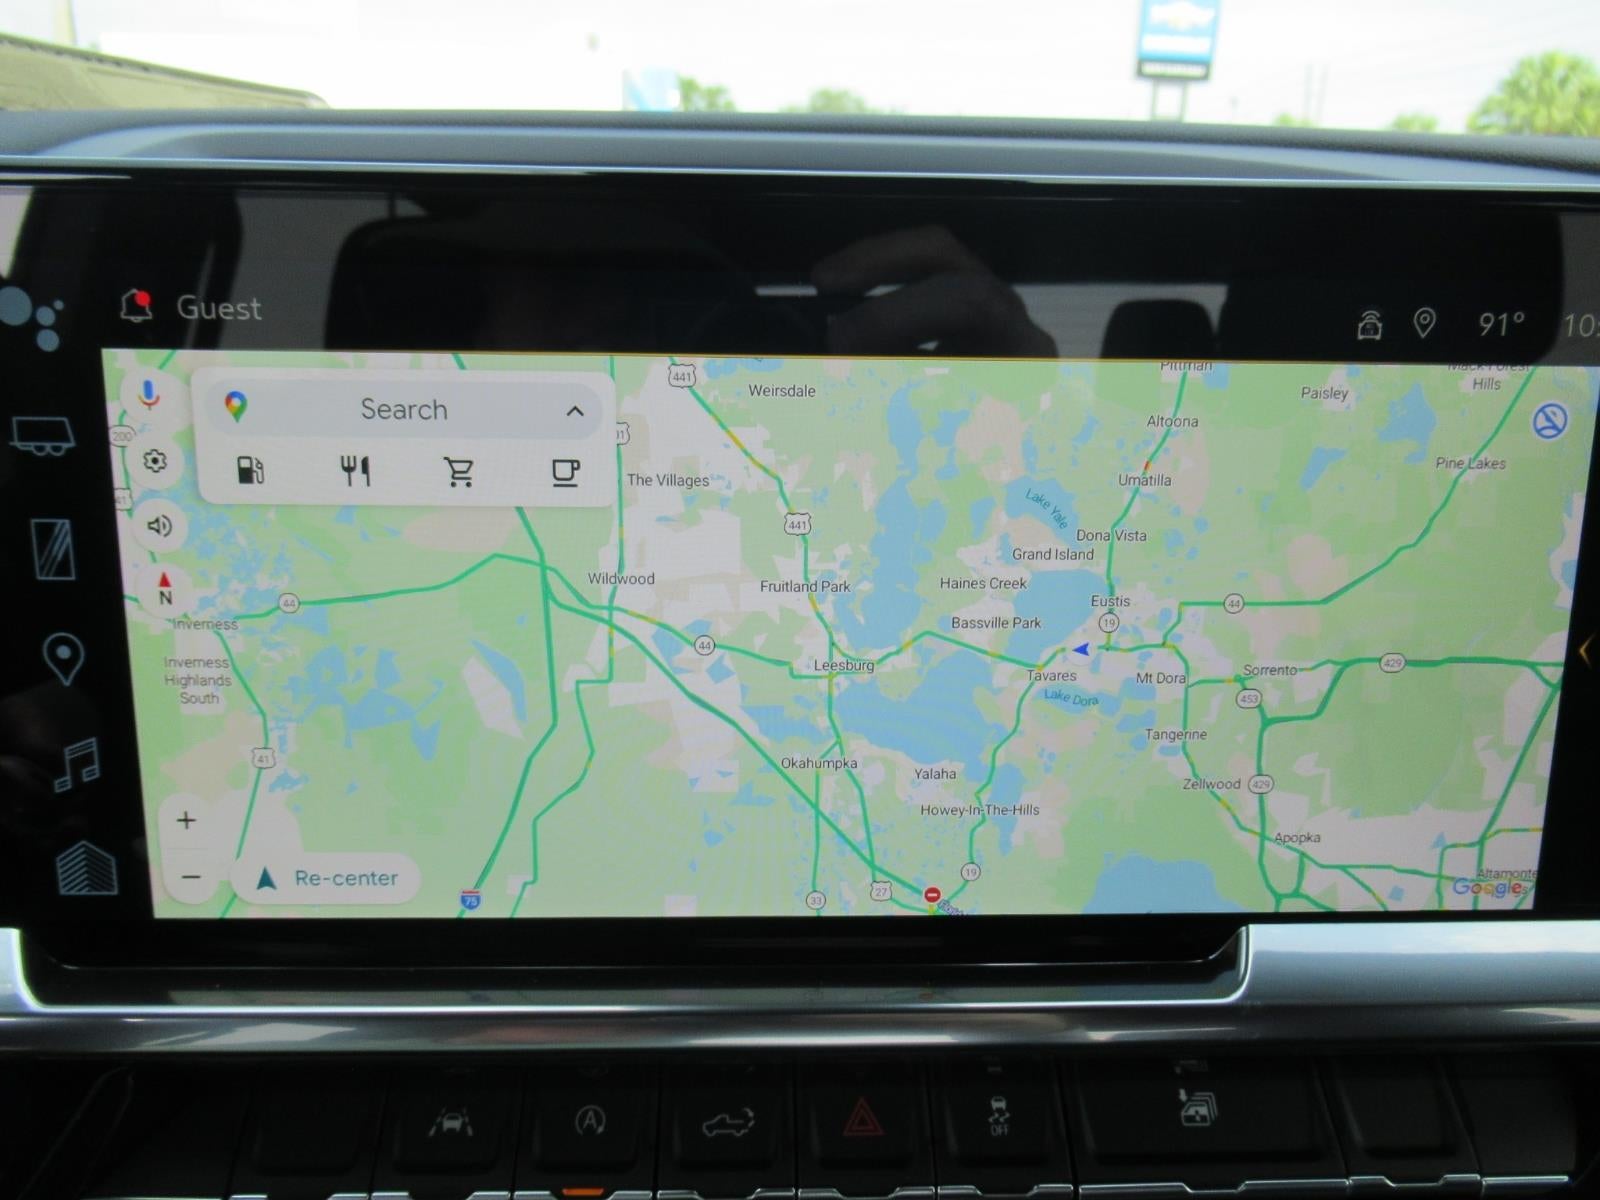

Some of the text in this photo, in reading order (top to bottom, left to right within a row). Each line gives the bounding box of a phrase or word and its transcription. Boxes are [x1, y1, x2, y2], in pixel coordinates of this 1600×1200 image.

[176, 294, 263, 321] Guest
[1479, 311, 1525, 337] 91°
[673, 372, 692, 382] 441
[1472, 377, 1502, 391] Hills
[748, 384, 817, 398] Weirsdale
[1301, 387, 1349, 402] Paisley
[360, 397, 449, 420] Search
[1147, 415, 1199, 428] Altoona
[1436, 456, 1506, 470] Pine Lakes
[627, 473, 710, 489] The Villages
[1118, 474, 1172, 487] Umatilla
[1025, 488, 1069, 530] Lake Yale
[788, 520, 807, 531] 441
[1076, 529, 1147, 542] Dona Vista
[1012, 548, 1094, 561] Grand Island
[588, 572, 656, 586] Wildwood
[940, 577, 1027, 590] Haines Creek
[760, 580, 851, 593] Fruitland Park
[159, 591, 173, 605] N
[282, 599, 296, 608] 44
[1091, 595, 1131, 608] Eustis
[1228, 599, 1241, 608] 44
[172, 618, 239, 631] Inverness
[951, 617, 1042, 630] Bassville Park
[1103, 618, 1116, 628] 19
[698, 641, 711, 650] 44
[164, 656, 230, 669] Inverness
[814, 659, 875, 674] Leesburg
[1383, 658, 1402, 668] 429
[1027, 670, 1077, 682] Tavares
[1243, 664, 1298, 677] Sorrento
[164, 674, 233, 688] Highlands
[1136, 671, 1186, 684] Mt Dora
[180, 692, 220, 705] South
[1044, 689, 1100, 707] Lake Dora
[1239, 694, 1259, 704] 453
[1145, 728, 1208, 743] Tangerine
[257, 754, 270, 764] 41
[781, 757, 858, 772] Okahumpka
[914, 768, 957, 781] Yalaha
[1183, 778, 1241, 790] Zellwood
[1251, 780, 1271, 790] 429
[920, 804, 1041, 817] Howey-In-The-Hills
[1275, 832, 1321, 845] Apopka
[295, 870, 399, 887] Re-center
[965, 867, 978, 877] 19
[875, 887, 888, 897] 27
[1452, 877, 1522, 898] Google
[810, 896, 823, 906] 33
[990, 1125, 1010, 1137] OFF
